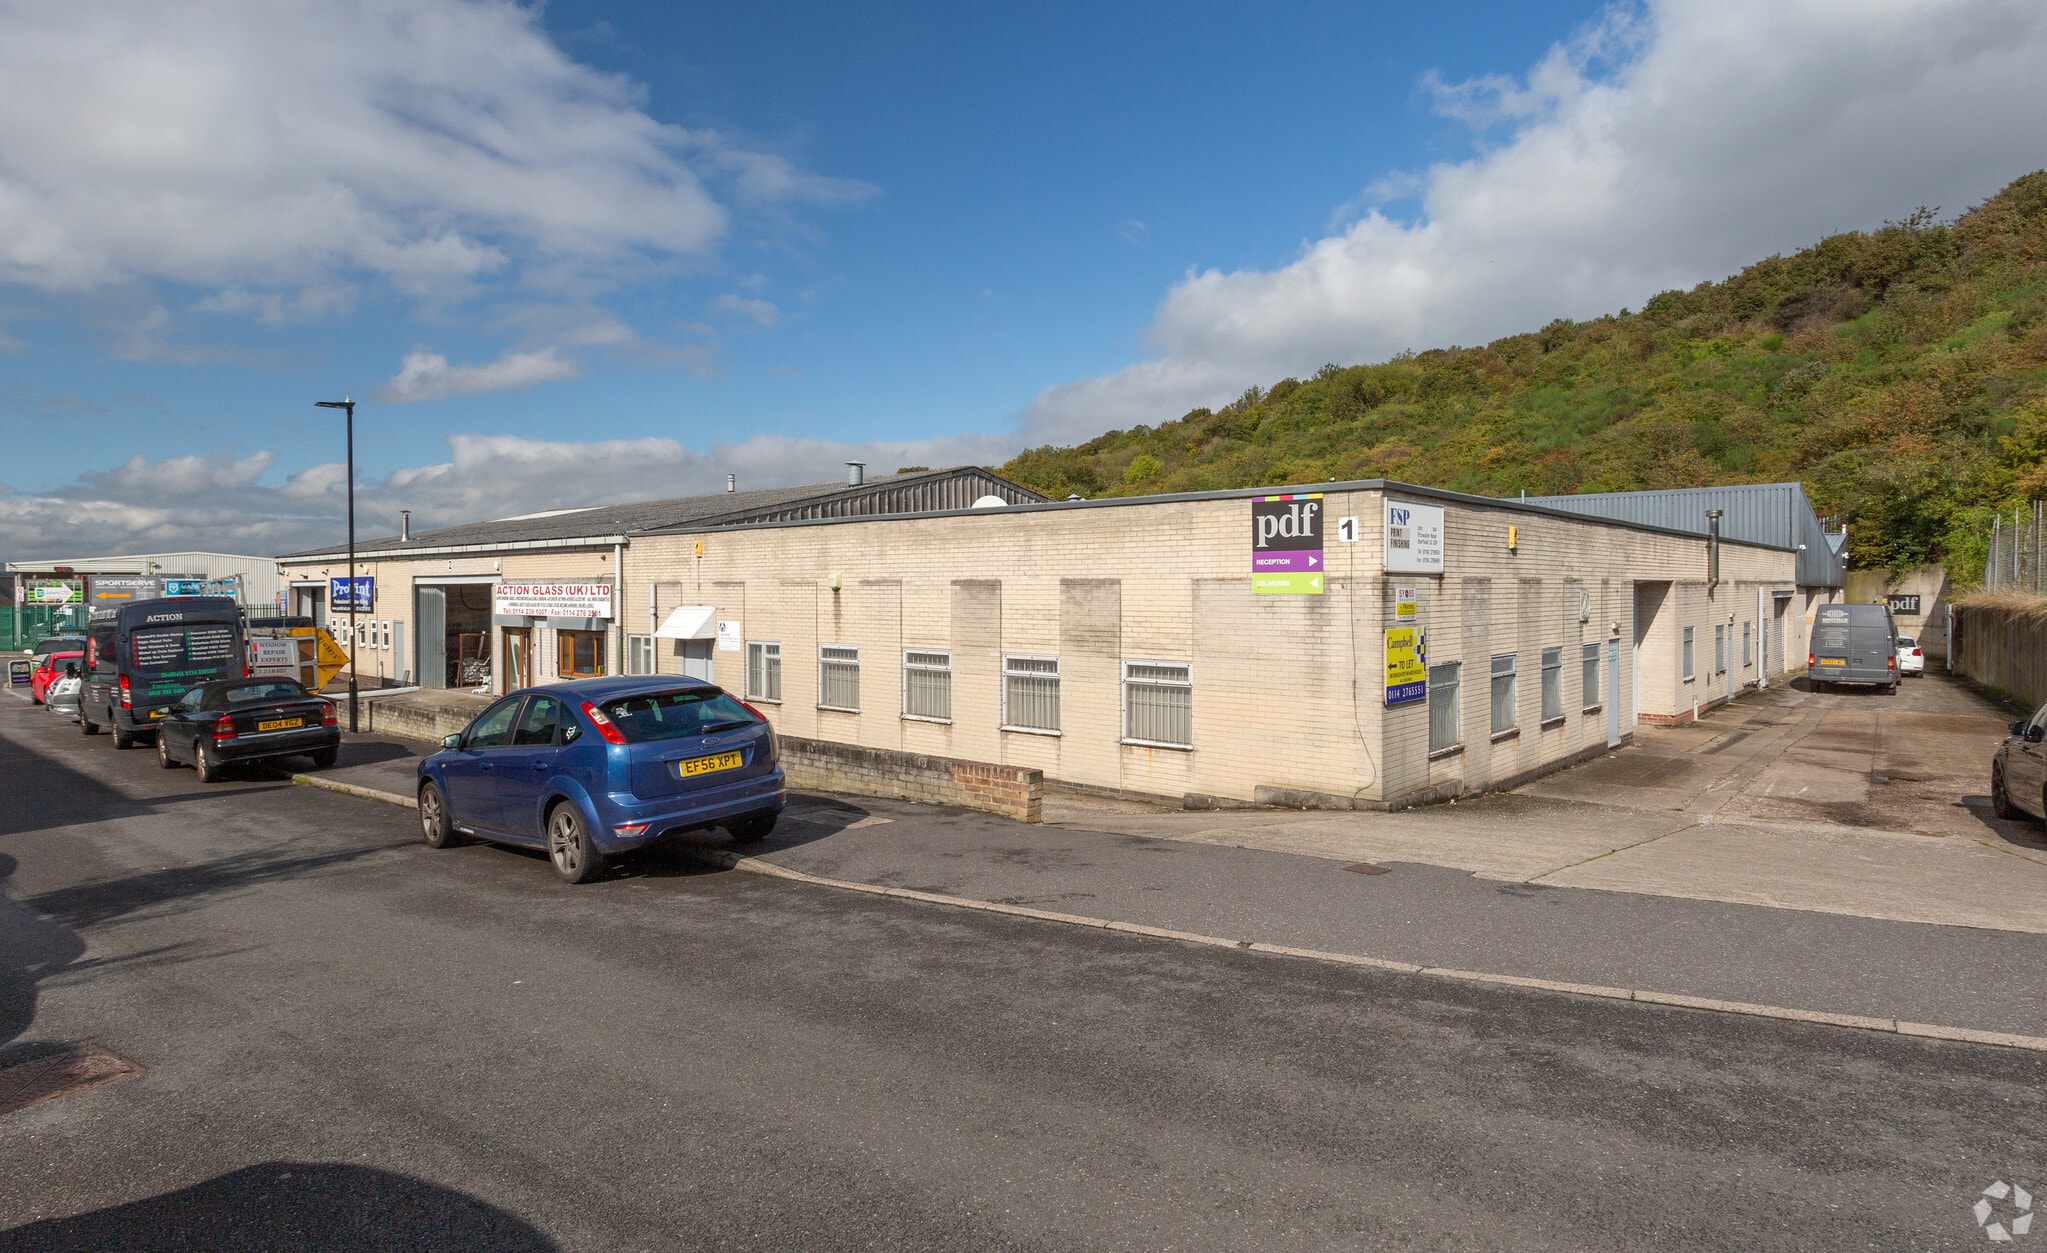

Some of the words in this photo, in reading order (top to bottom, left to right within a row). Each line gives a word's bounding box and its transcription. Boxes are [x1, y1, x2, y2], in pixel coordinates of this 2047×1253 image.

[1390, 508, 1410, 526] FSP
[1256, 502, 1318, 548] pdf
[1342, 519, 1352, 540] 1
[1390, 528, 1402, 537] PRINT
[1390, 538, 1410, 549] FINISHING
[496, 586, 529, 595] ACTION
[532, 586, 563, 595] GLASS
[566, 586, 588, 595] (UK)
[590, 586, 610, 595] LTD
[1890, 597, 1918, 613] pdf
[147, 613, 183, 622] ACTION
[1387, 635, 1413, 652] Campbell
[1399, 660, 1405, 670] TO
[1388, 689, 1400, 700] 0114
[1402, 685, 1423, 698] 2765551
[686, 758, 715, 773] EF56
[717, 754, 736, 767] XPT
